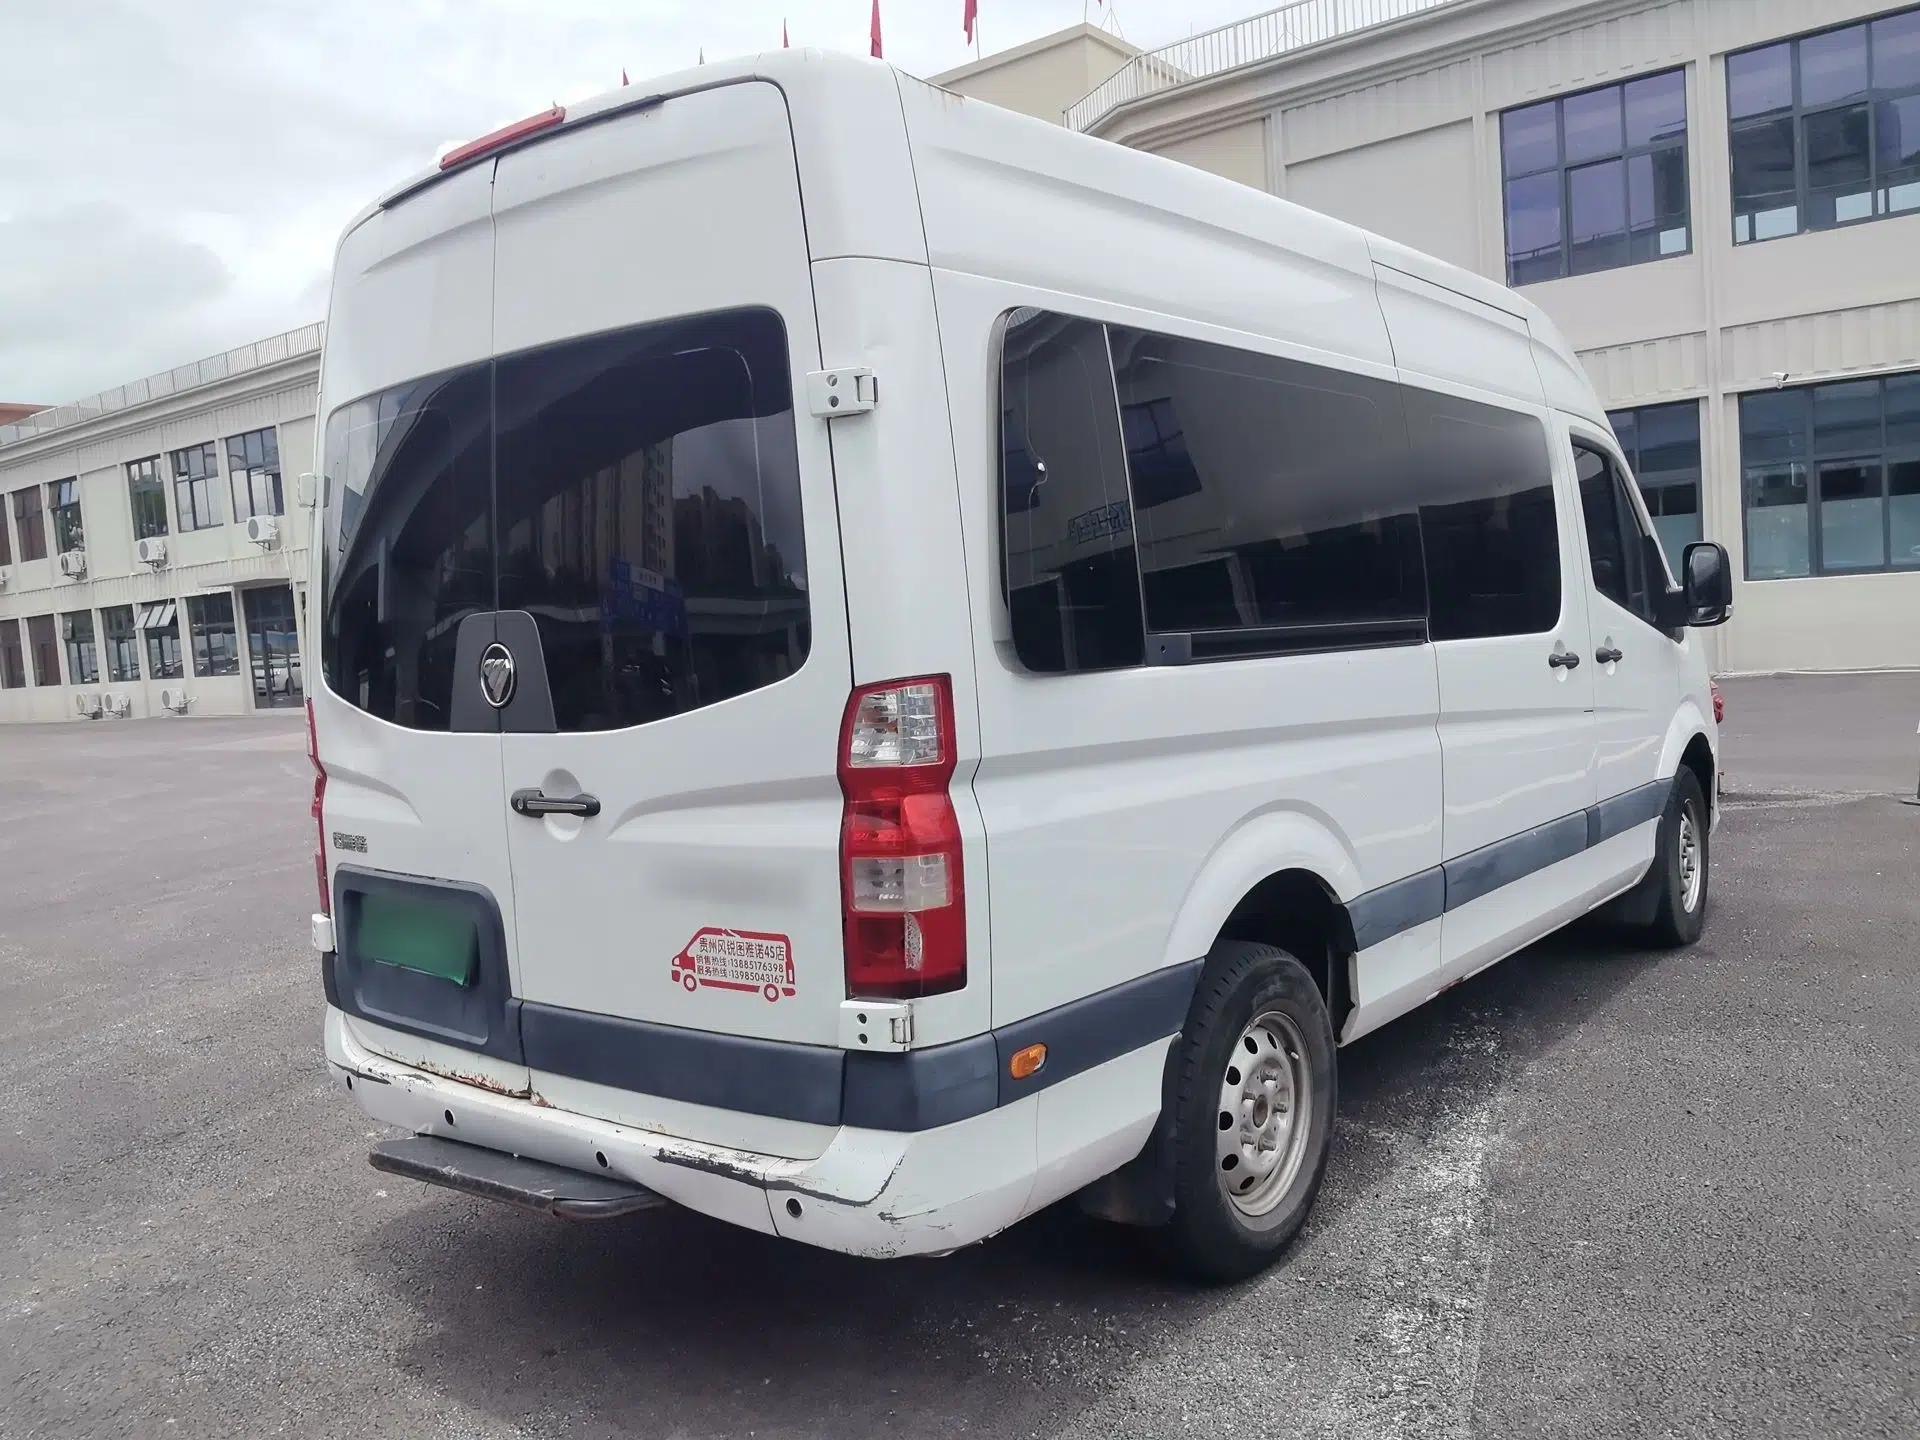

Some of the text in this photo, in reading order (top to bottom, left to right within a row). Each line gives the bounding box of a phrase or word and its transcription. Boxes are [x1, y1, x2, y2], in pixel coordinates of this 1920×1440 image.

[699, 937, 784, 961] 贵州风锐图雅诺4S店
